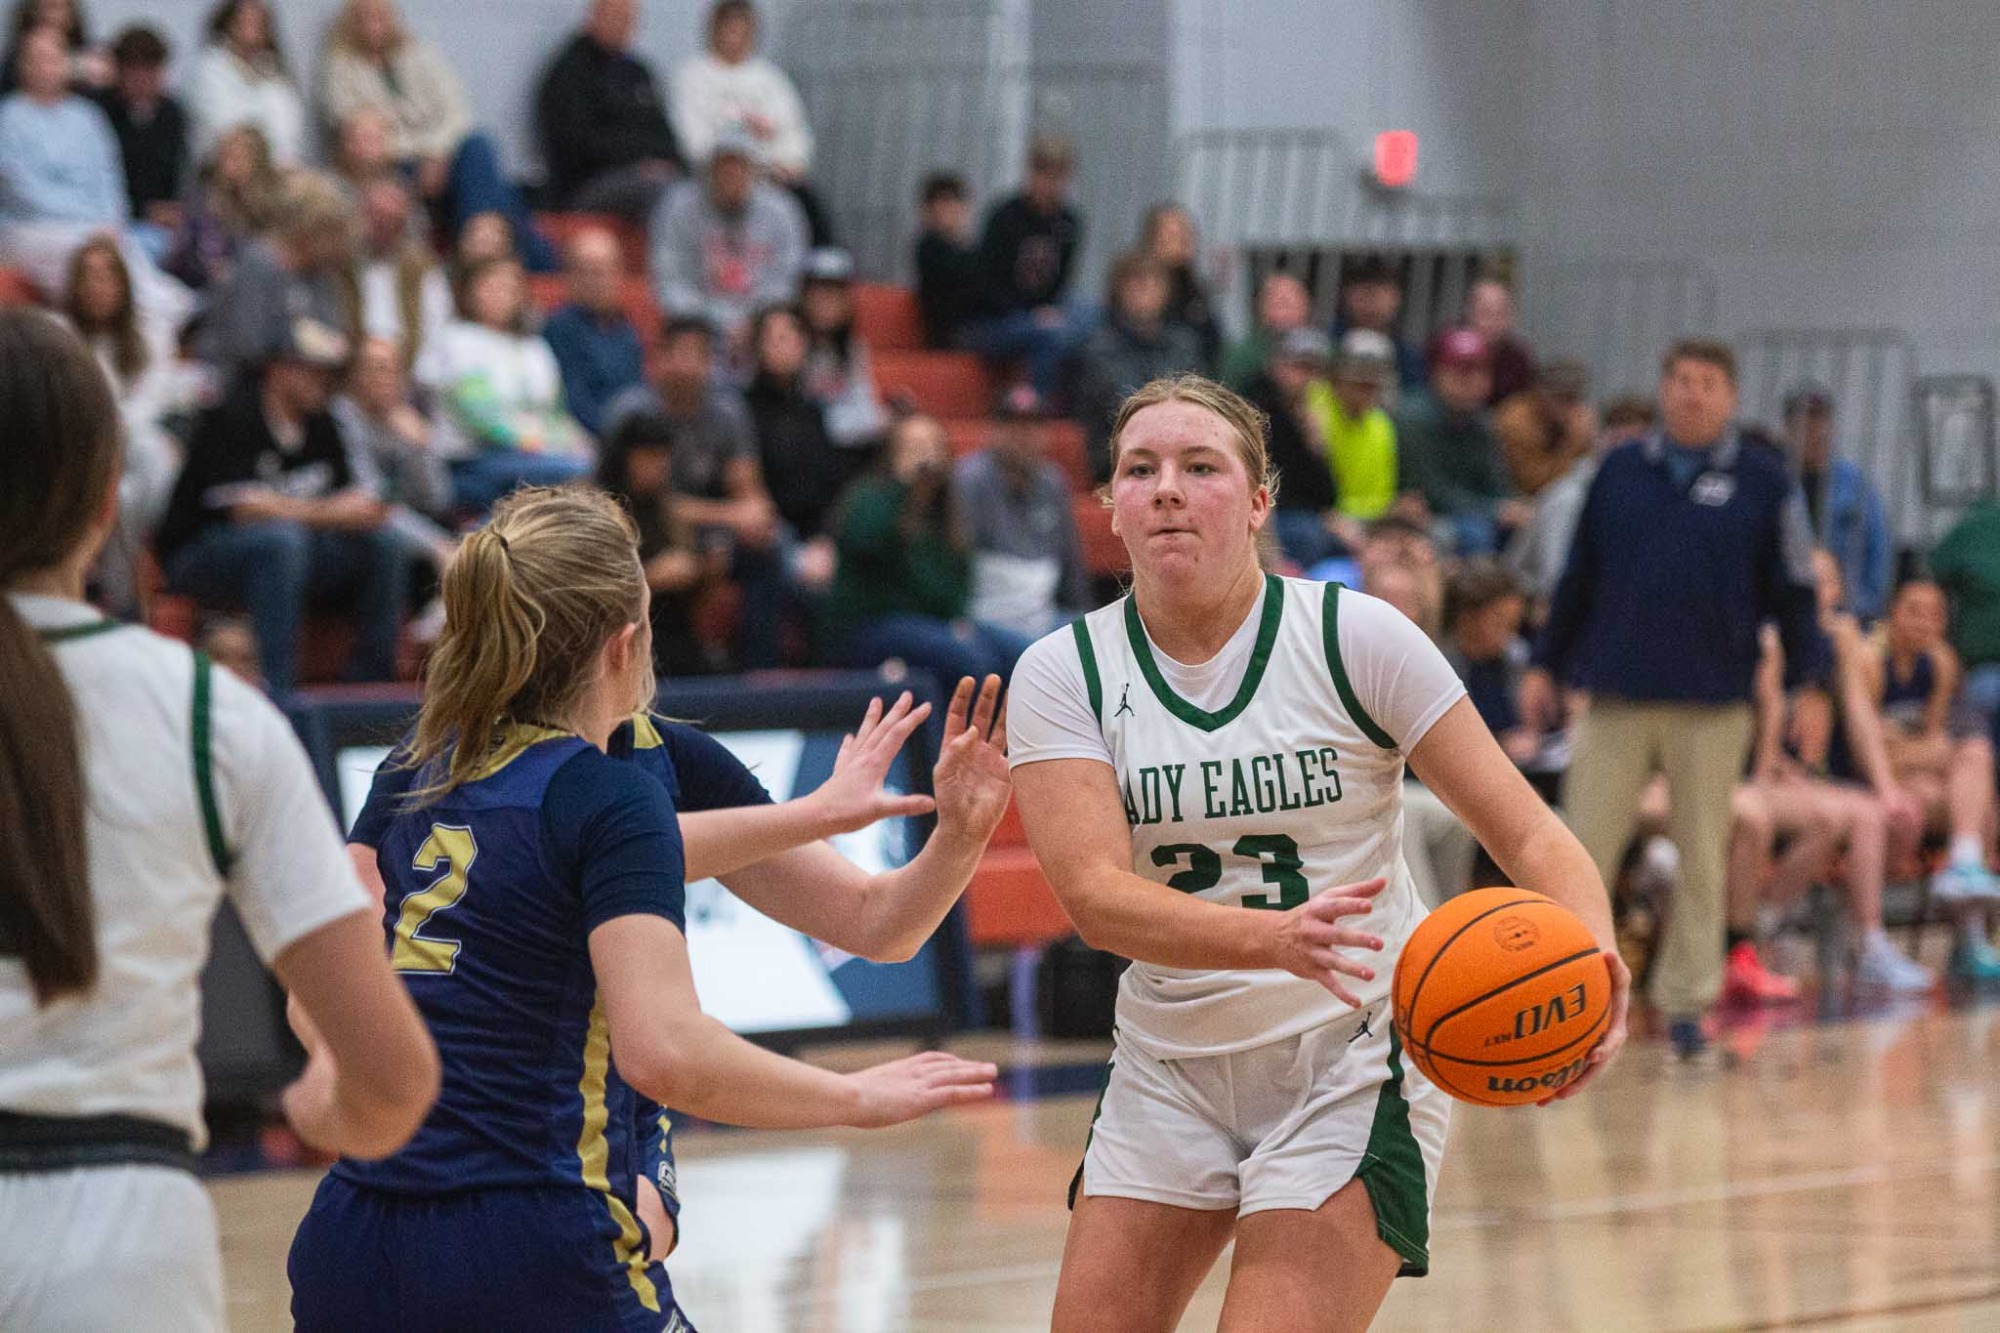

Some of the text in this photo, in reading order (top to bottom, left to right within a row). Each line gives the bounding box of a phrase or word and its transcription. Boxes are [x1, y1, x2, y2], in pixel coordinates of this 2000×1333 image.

[1199, 747, 1343, 819] EAGLES
[391, 821, 479, 976] 2
[1150, 833, 1310, 912] 23
[1513, 983, 1588, 1041] EVO
[1487, 1054, 1590, 1093] ilson
